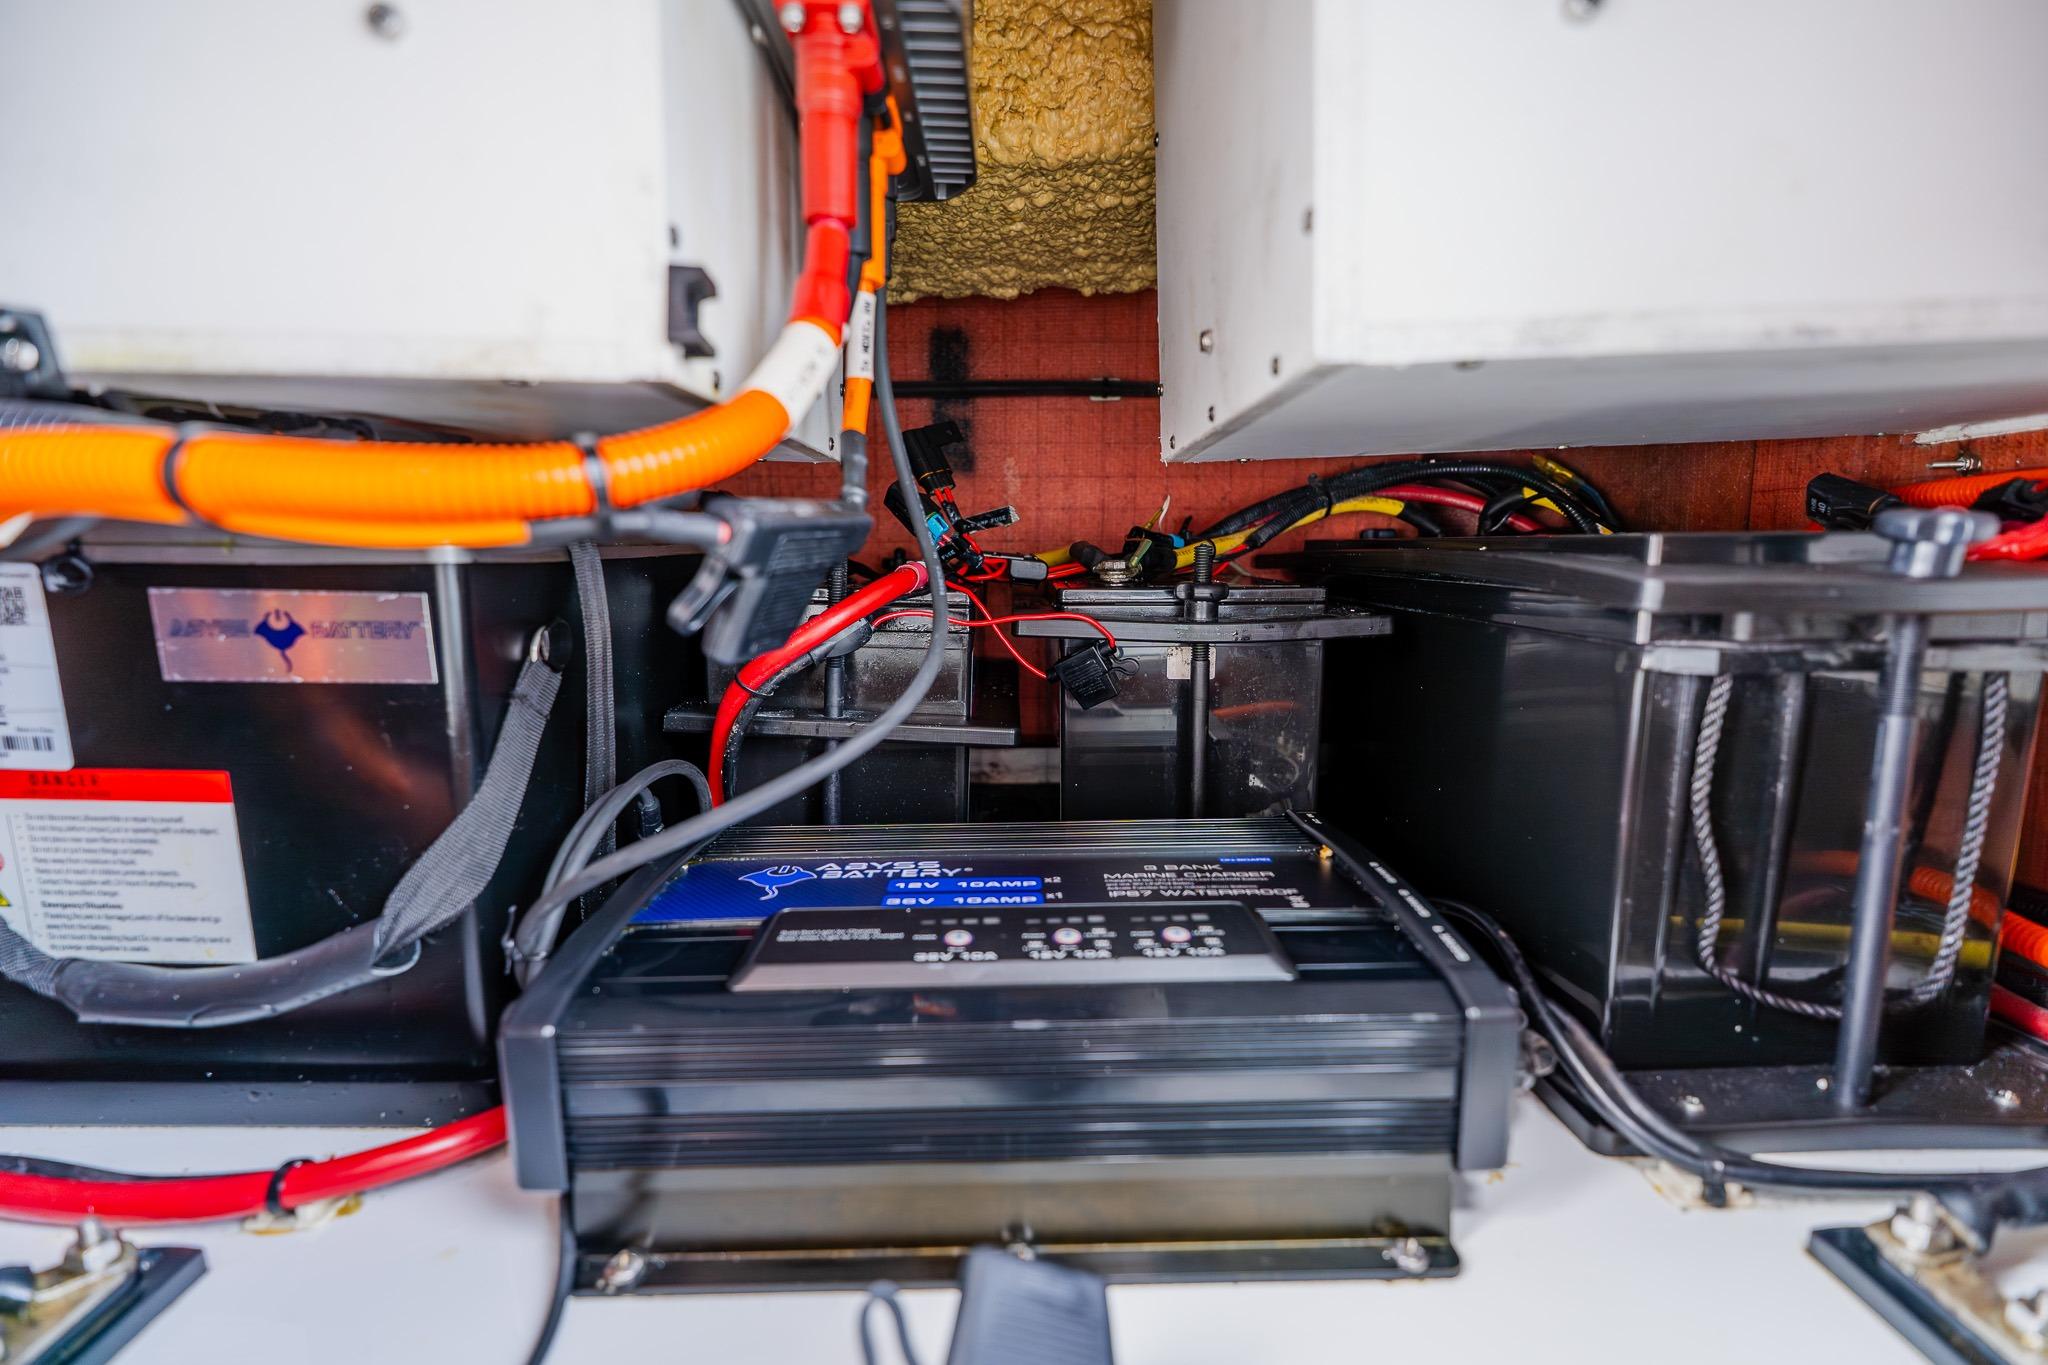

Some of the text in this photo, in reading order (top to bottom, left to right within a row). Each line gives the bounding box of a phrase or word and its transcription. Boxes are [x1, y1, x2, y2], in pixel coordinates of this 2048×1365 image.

[815, 861, 940, 871] ABYSS
[1164, 863, 1223, 871] BANK
[821, 868, 961, 879] BATTERY
[1183, 870, 1276, 879] CHARGER
[1160, 887, 1299, 898] WATERPROOF
[954, 896, 1037, 904] 10AMP
